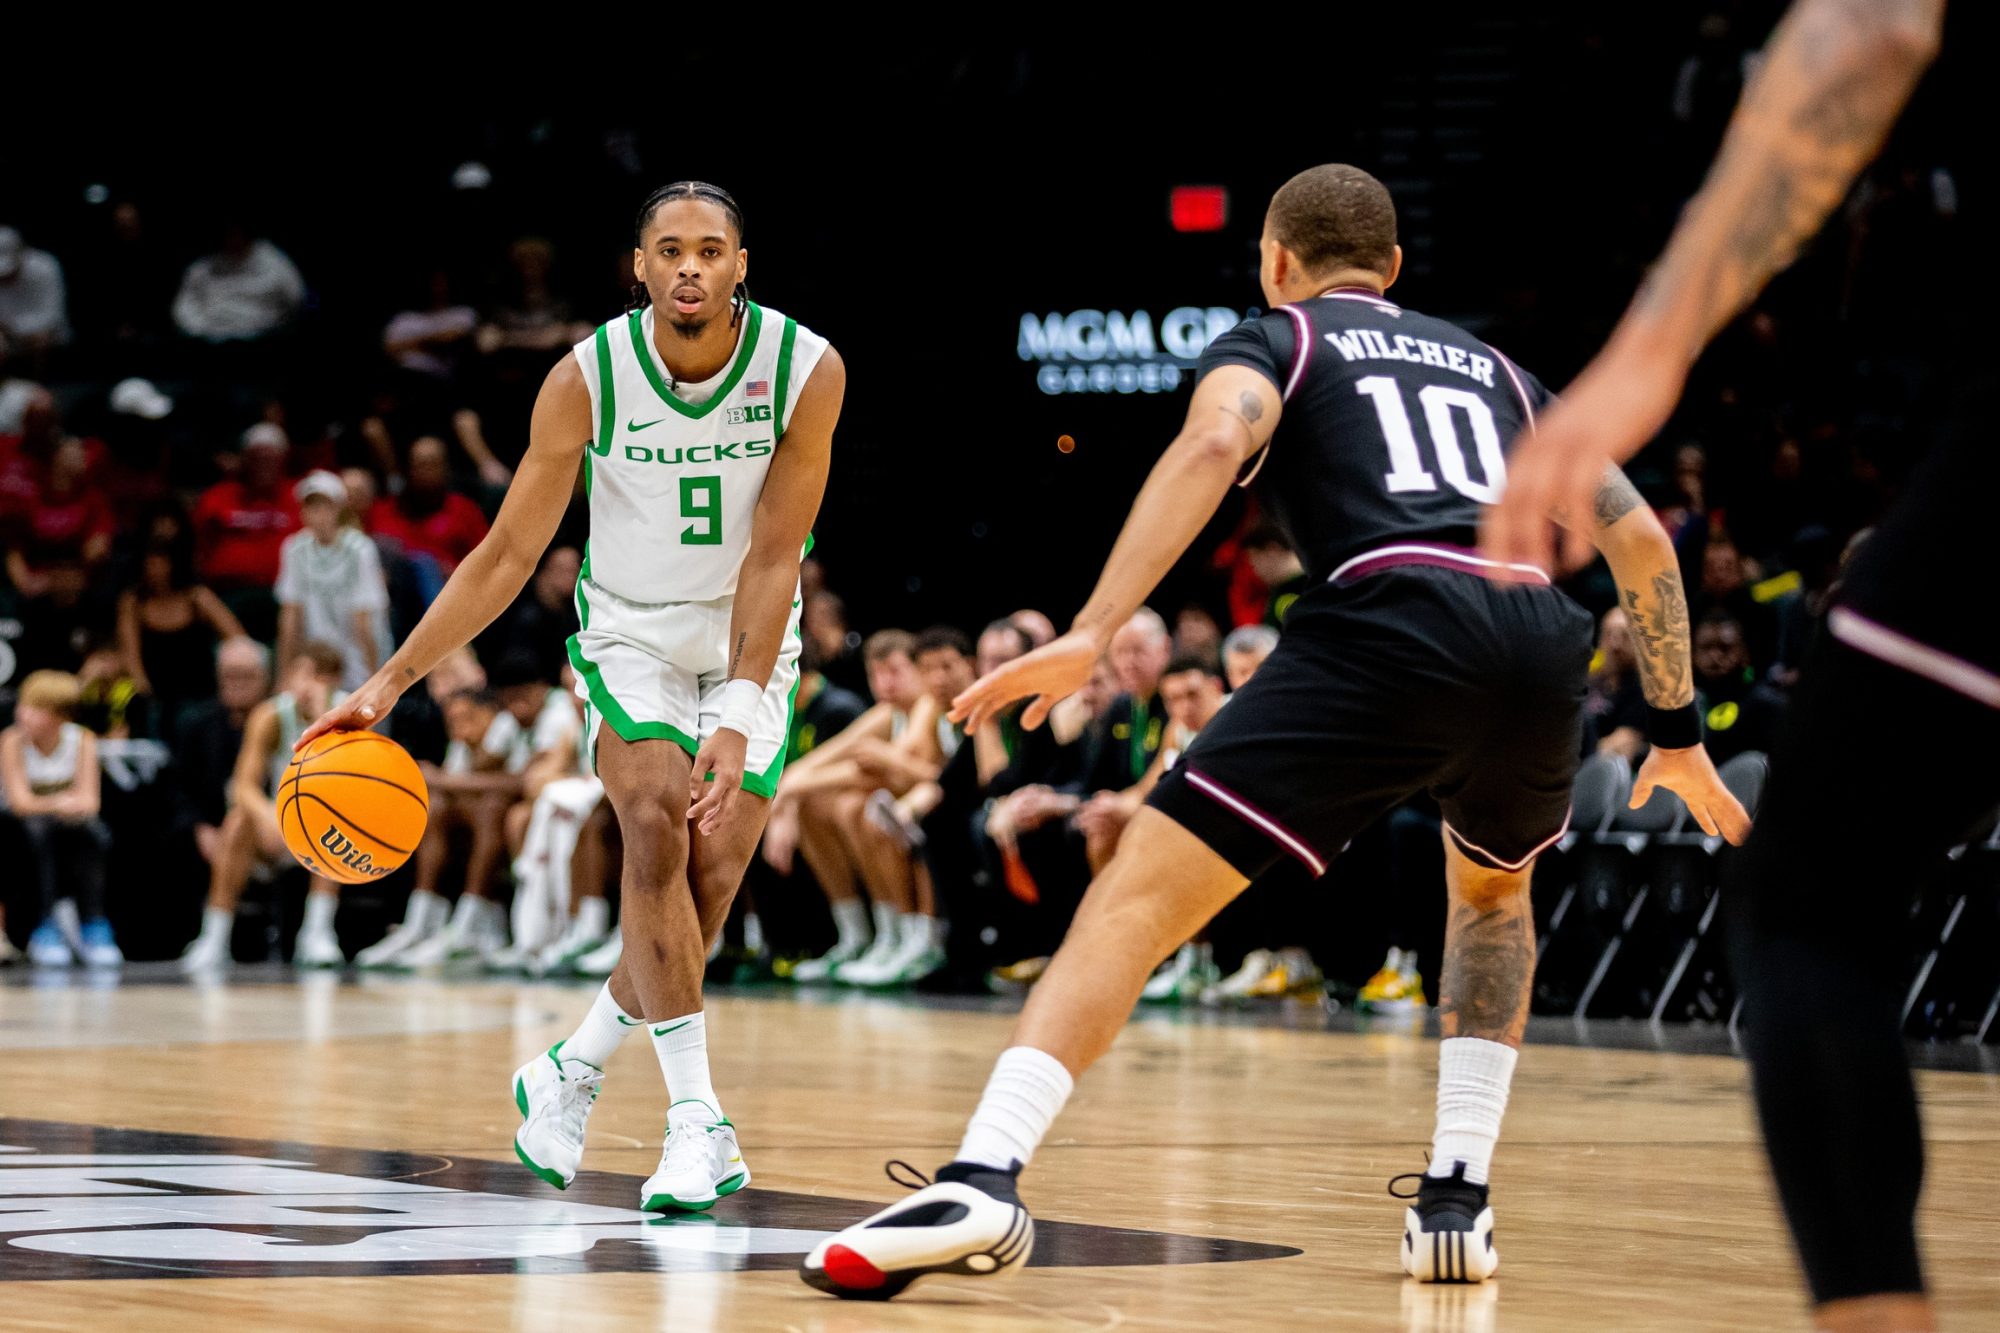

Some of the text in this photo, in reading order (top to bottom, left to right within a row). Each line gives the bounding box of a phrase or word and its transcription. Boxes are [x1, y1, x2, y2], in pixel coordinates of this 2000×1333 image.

[1017, 306, 1244, 361] MGM GR
[1324, 329, 1495, 389] WILCHER
[625, 439, 772, 464] DUCKS
[1355, 375, 1508, 505] 10
[679, 475, 723, 545] 9
